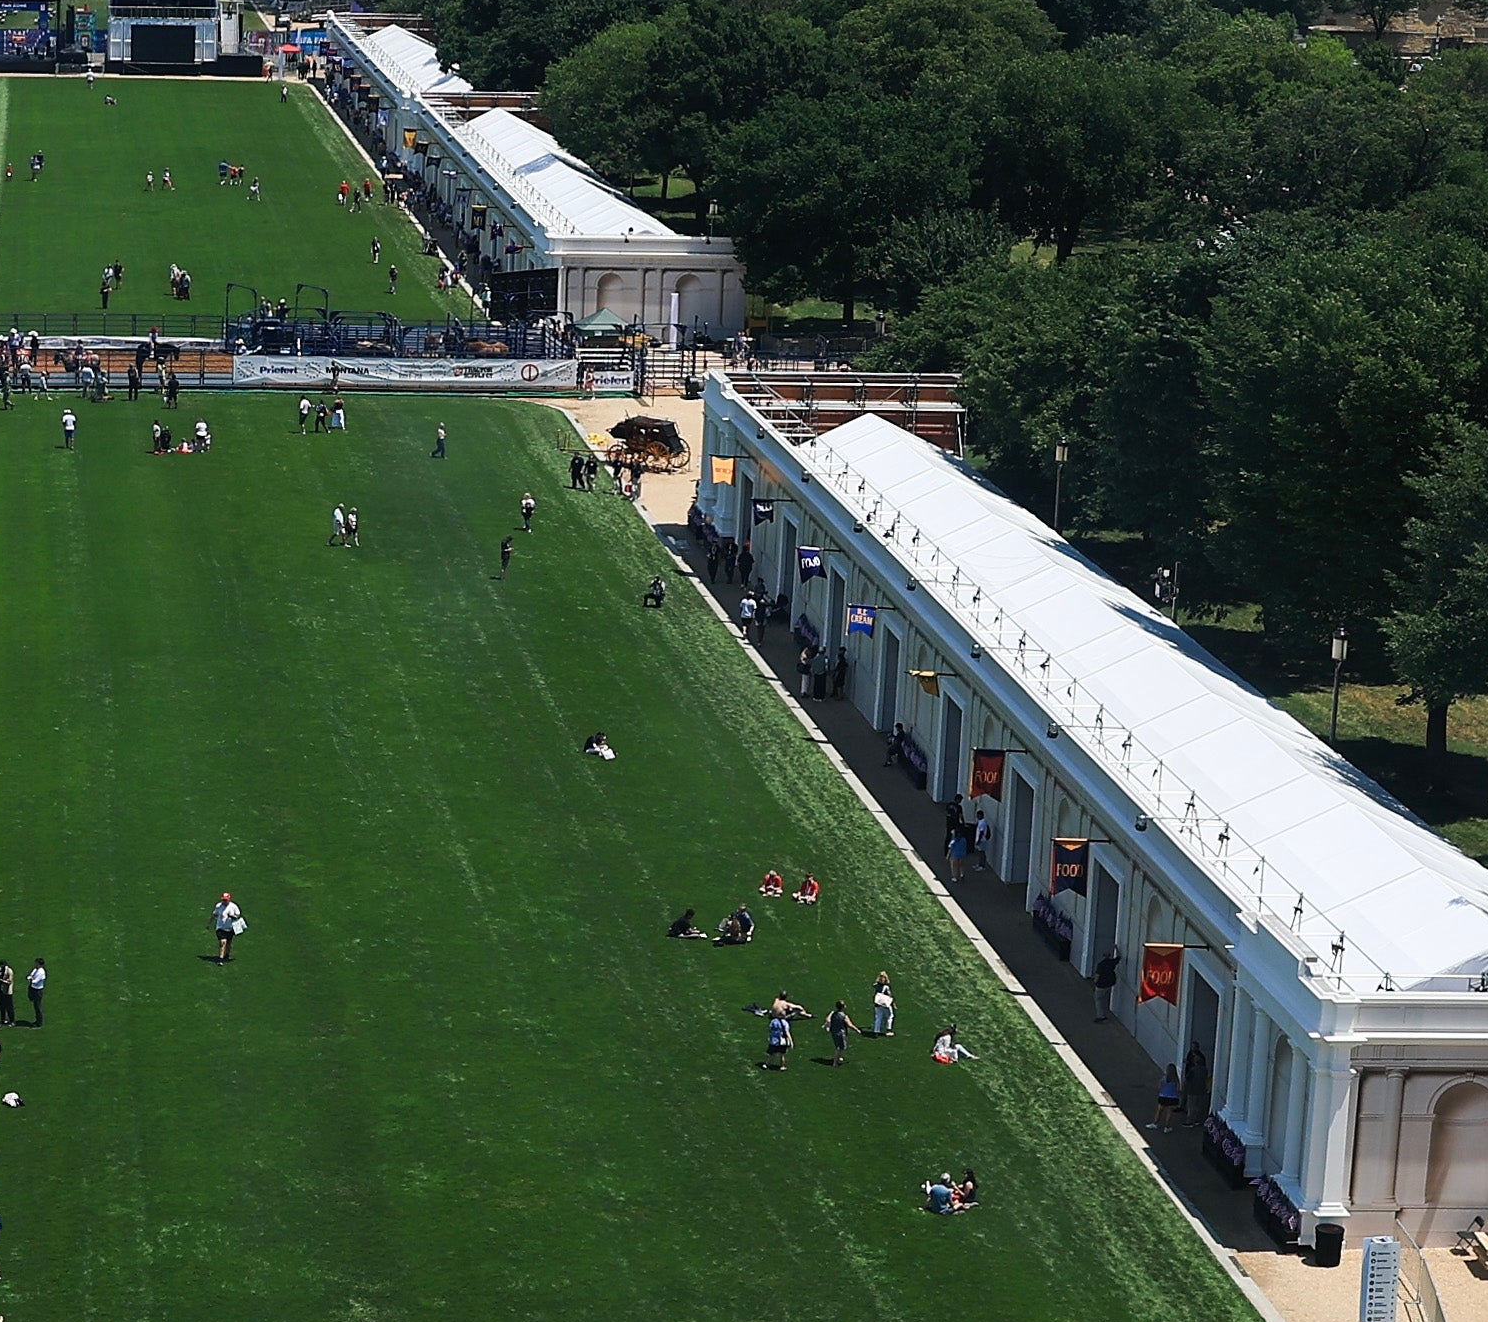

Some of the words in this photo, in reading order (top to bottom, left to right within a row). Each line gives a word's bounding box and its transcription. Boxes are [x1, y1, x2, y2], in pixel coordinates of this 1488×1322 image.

[259, 365, 298, 374] Priefert
[850, 614, 874, 625] CREAM
[1056, 861, 1084, 879] FOOD
